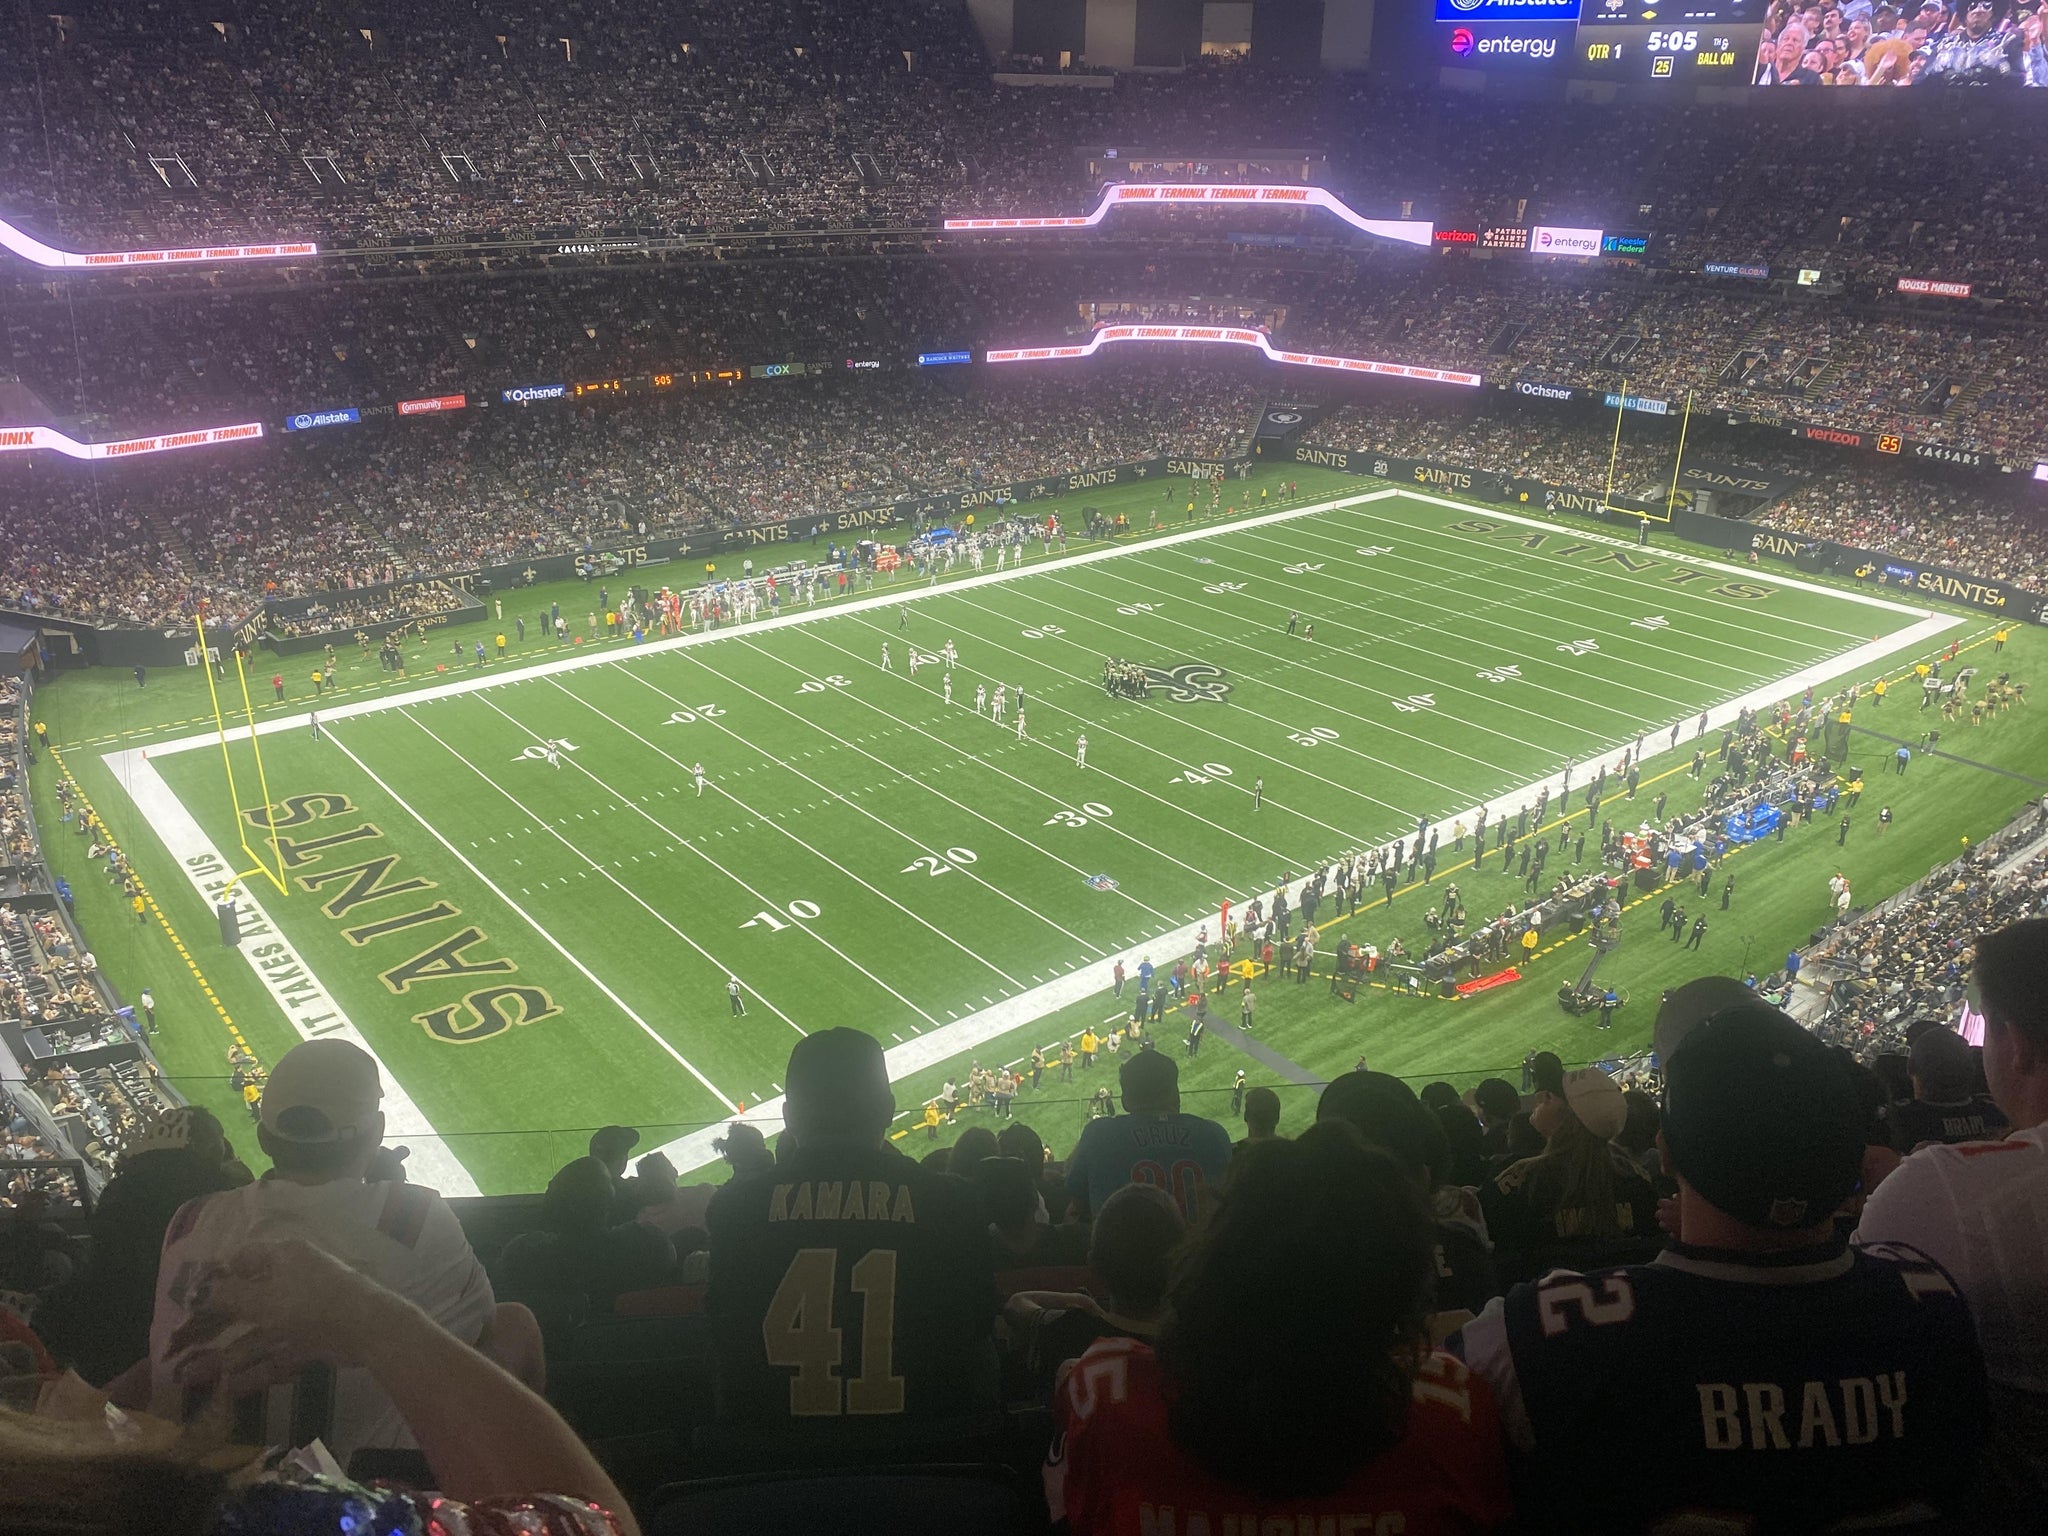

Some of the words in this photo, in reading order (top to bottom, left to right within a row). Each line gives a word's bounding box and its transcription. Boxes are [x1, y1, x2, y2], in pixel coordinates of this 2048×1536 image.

[1478, 36, 1556, 58] entergy
[1648, 31, 1697, 50] 5:05
[1588, 44, 1609, 59] QTR
[1614, 45, 1622, 58] 1
[1697, 53, 1718, 64] BALL
[1720, 53, 1734, 64] ON
[1656, 60, 1670, 73] 25
[1118, 188, 1156, 198] TERMINIX
[1160, 188, 1207, 199] TERMINIX
[1210, 188, 1257, 200] TERMINIX
[1261, 189, 1308, 200] TERMINIX
[505, 232, 536, 242] SAINTS
[1435, 230, 1476, 242] verizon
[1494, 234, 1527, 242] SAINTS
[1496, 228, 1527, 236] PATRON
[357, 238, 391, 248] SAINTS
[434, 235, 466, 245] SAINTS
[1554, 237, 1597, 250] entergy
[1619, 237, 1647, 246] Keesler
[85, 255, 124, 264] TERMINIX
[128, 253, 164, 262] TERMINIX
[167, 251, 202, 260] TERMINIX
[206, 249, 240, 258] TERMINIX
[243, 247, 276, 256] TERMINIX
[280, 245, 312, 254] TERMINIX
[1618, 244, 1645, 253] Federal
[1706, 264, 1738, 274] VENTURE
[1739, 266, 1768, 276] GLOBAL
[1899, 280, 1930, 292] ROUSES
[1932, 282, 1970, 294] MARKETS
[1104, 328, 1134, 339] TERMINIX
[1137, 327, 1178, 338] TERMINIX
[1181, 328, 1222, 338] TERMINIX
[1226, 330, 1257, 342] TERMINIX
[989, 352, 1019, 360] TERMINIX
[1021, 350, 1051, 358] TERMINIX
[1054, 348, 1082, 356] TERMINIX
[766, 364, 789, 376] COX
[854, 360, 880, 370] entergy
[1281, 352, 1309, 362] TERMINIX
[1312, 356, 1340, 366] TERMINIX
[1342, 360, 1372, 370] TERMINIX
[1374, 364, 1405, 374] TERMINIX
[1408, 367, 1439, 378] TERMINIX
[1441, 370, 1472, 382] TERMINIX
[654, 376, 672, 386] 5:05
[736, 372, 742, 380] 3
[576, 386, 582, 396] 3
[613, 380, 619, 390] 6
[1522, 383, 1571, 400] Ochsner
[513, 388, 564, 402] Ochsner
[402, 400, 442, 414] Community
[1606, 395, 1636, 408] PEOLES
[1638, 400, 1666, 412] HEALTH
[1681, 404, 1711, 418] SINTS
[361, 406, 394, 417] SAINTS
[1750, 416, 1782, 426] SAINTS
[0, 432, 33, 445] INIX
[106, 440, 156, 456] TERMINIX
[161, 432, 208, 448] TERMINIX
[213, 426, 258, 441] TERMINIX
[1806, 427, 1860, 446] verizon
[1881, 437, 1898, 451] 25
[1296, 448, 1346, 468] SAINTS
[1915, 446, 1980, 466] CAESARS
[1994, 456, 2034, 471] SAINTS
[1166, 459, 1224, 477] SAINTS
[1374, 462, 1388, 474] 20
[1069, 469, 1117, 490] SAINTS
[1414, 467, 1471, 488] SAINTS
[1684, 468, 1770, 490] SAINTS
[961, 487, 1012, 508] SAINTS
[1564, 528, 1645, 551] CHOOS
[1648, 548, 1712, 566] LOVE
[1444, 519, 1779, 600] SAINTS
[1282, 562, 1321, 574] 20
[1203, 582, 1242, 594] 30
[1918, 572, 2000, 606] SAINTS
[1116, 602, 1154, 616] 40
[416, 614, 448, 627] SAINTS
[1630, 616, 1670, 631] 10
[1021, 624, 1066, 638] 50
[1556, 640, 1600, 656] 20
[1476, 664, 1518, 683] 30
[803, 674, 852, 692] 30
[1392, 695, 1436, 713] 40
[670, 703, 726, 724] 20
[1287, 727, 1340, 747] 50
[522, 738, 580, 759] 10
[1184, 762, 1233, 784] 40
[1052, 802, 1114, 828] 30
[186, 852, 224, 878] US
[912, 847, 978, 877] 20
[240, 793, 565, 1045] SAINTS
[753, 899, 821, 933] 10
[252, 941, 322, 1010] TAKES
[300, 1011, 345, 1038] IT
[1130, 1125, 1192, 1150] CRUZ
[769, 1181, 915, 1222] KAMARA
[762, 1248, 906, 1416] 41
[1696, 1371, 1908, 1450] BRADY
